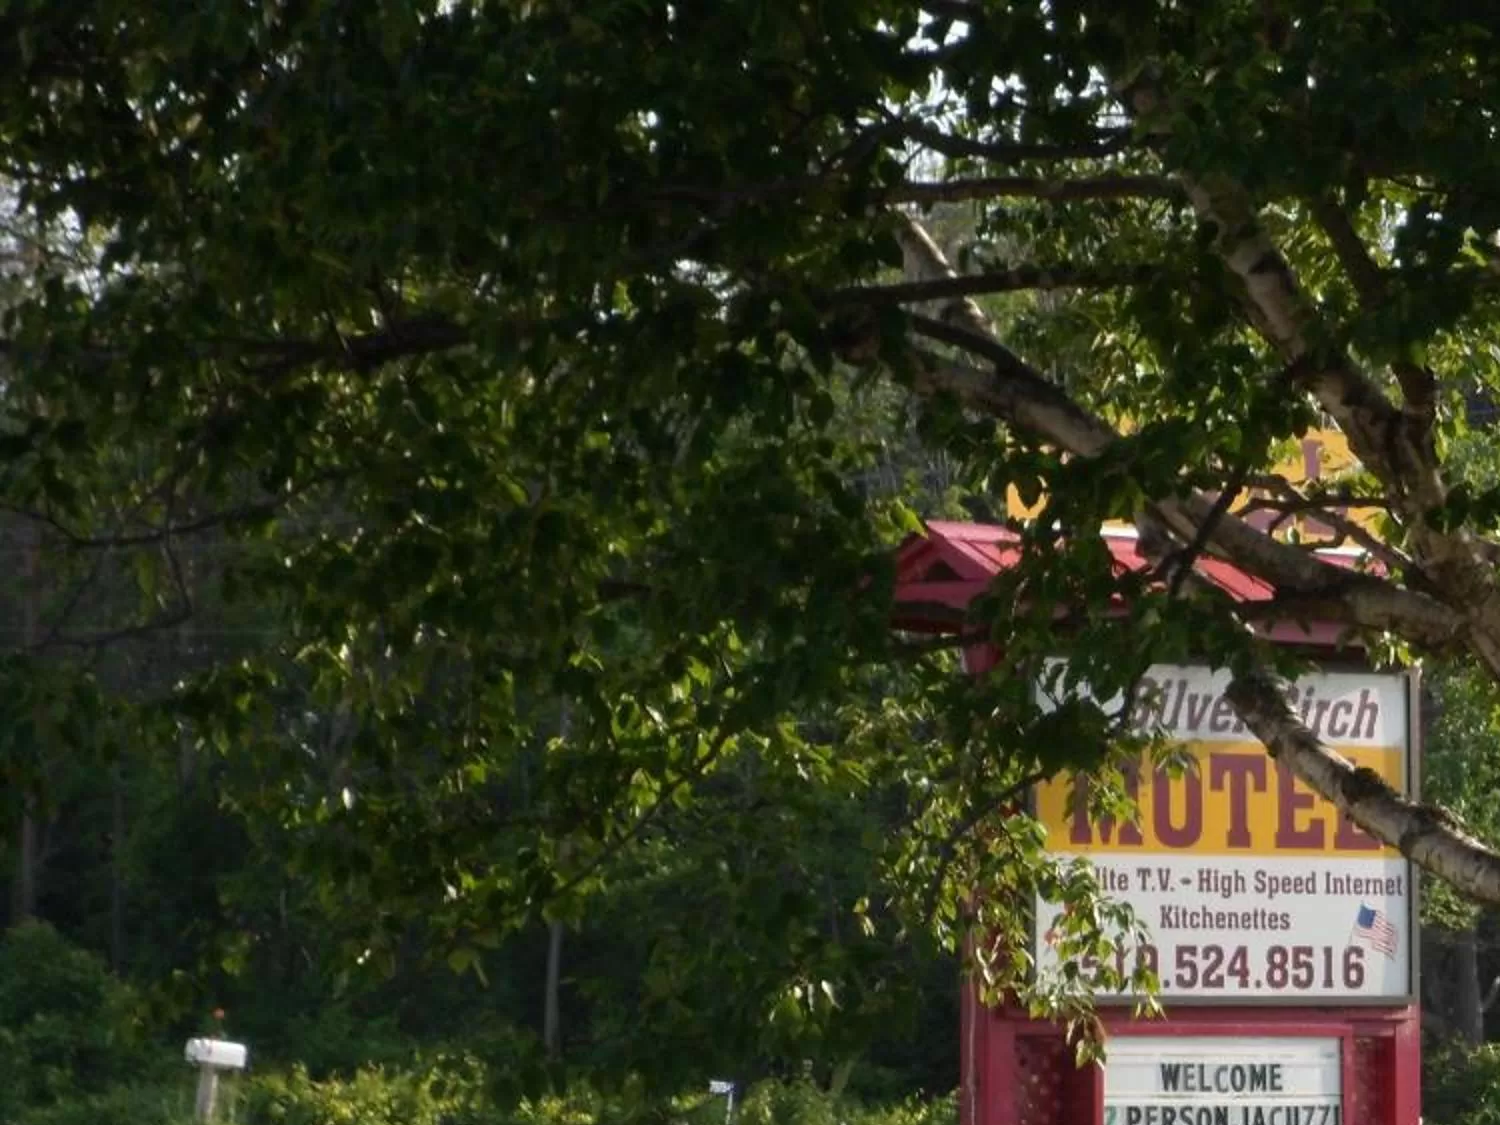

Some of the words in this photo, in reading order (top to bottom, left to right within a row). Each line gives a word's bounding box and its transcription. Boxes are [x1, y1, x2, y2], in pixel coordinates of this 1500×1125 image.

[1132, 677, 1247, 733] Silve
[1136, 867, 1175, 892] T.V.
[1197, 867, 1246, 899] High
[1254, 869, 1317, 899] Speed
[1325, 871, 1403, 896] Internet
[1160, 904, 1291, 930] Kitchenettes
[1161, 1063, 1283, 1093] WELCOME
